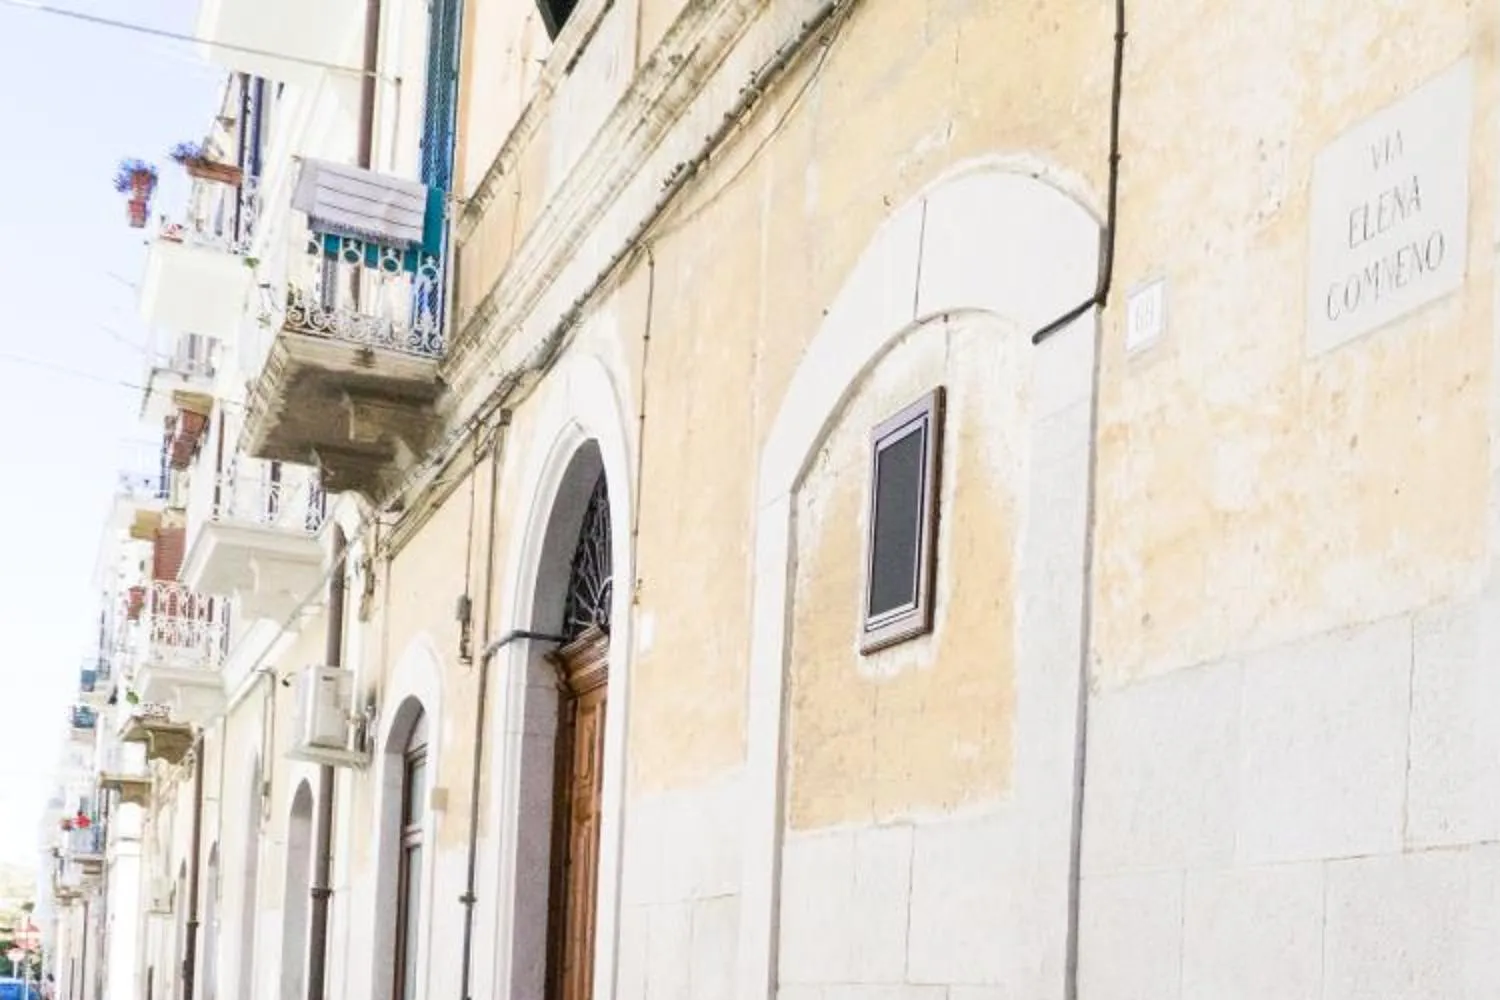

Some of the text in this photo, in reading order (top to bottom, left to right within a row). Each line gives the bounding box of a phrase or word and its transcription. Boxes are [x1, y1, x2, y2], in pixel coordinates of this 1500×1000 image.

[1371, 129, 1403, 171] VIA
[1349, 175, 1422, 250] ELENA
[1327, 230, 1445, 322] COMNENO
